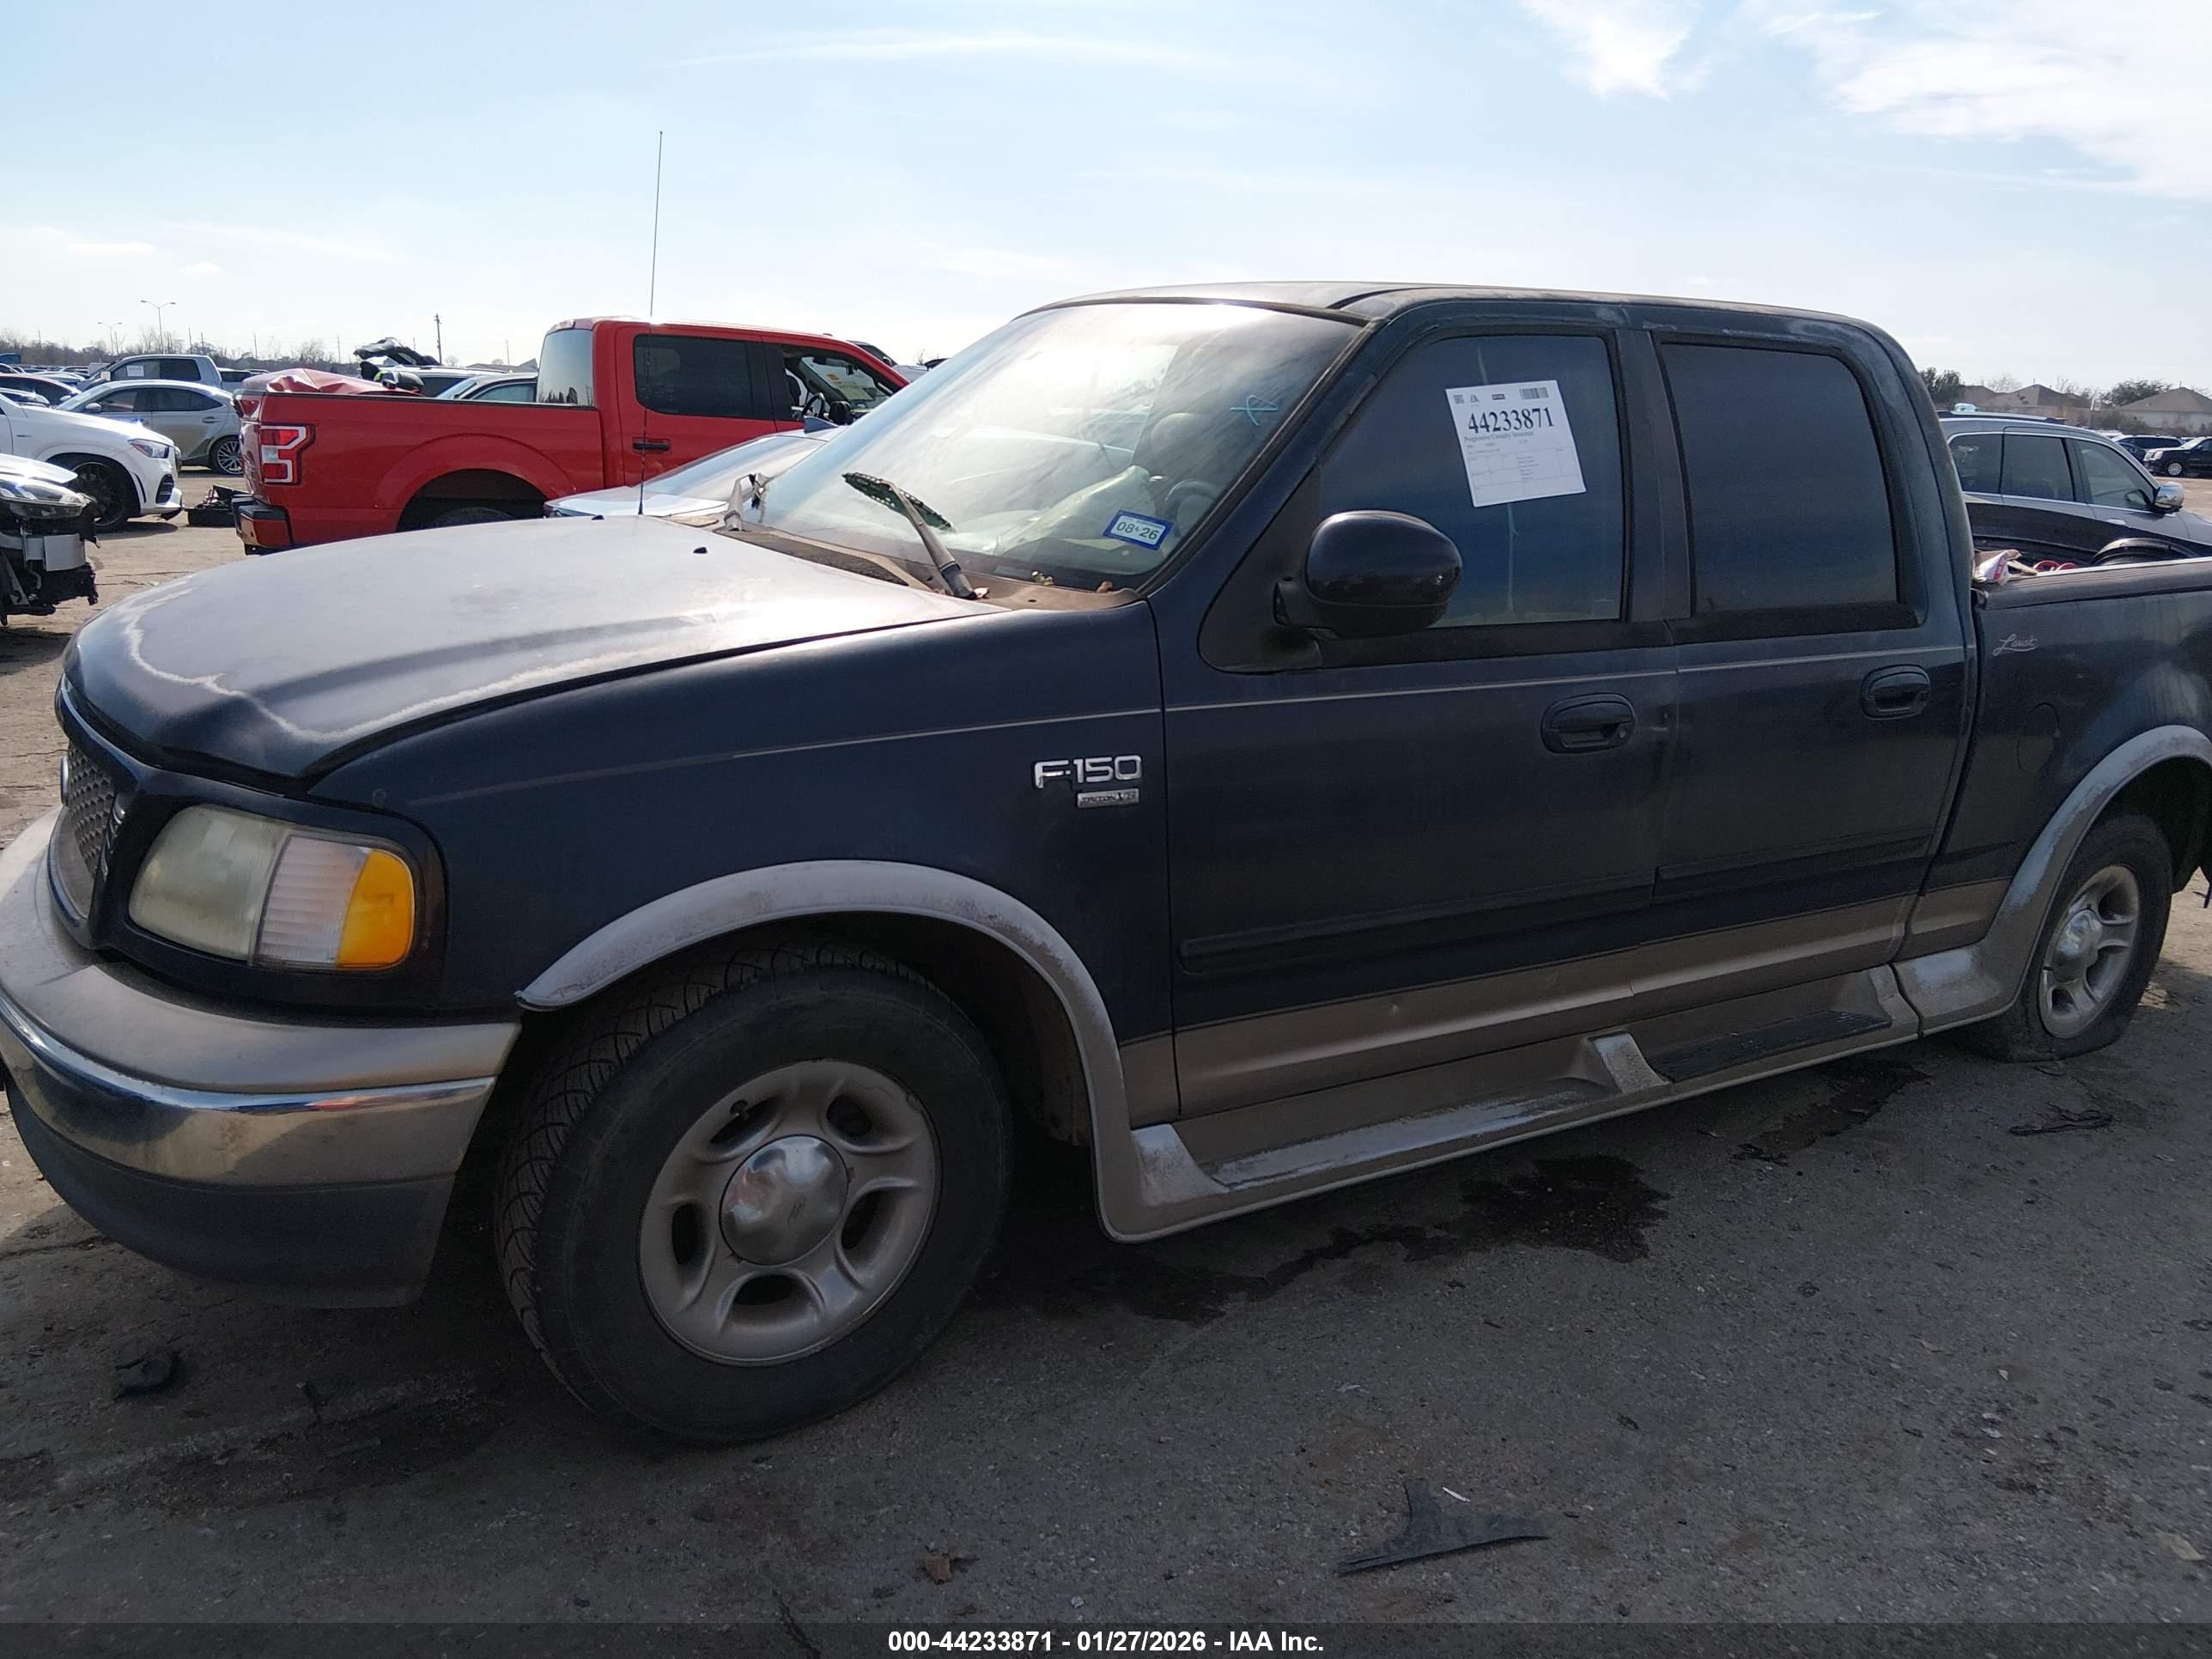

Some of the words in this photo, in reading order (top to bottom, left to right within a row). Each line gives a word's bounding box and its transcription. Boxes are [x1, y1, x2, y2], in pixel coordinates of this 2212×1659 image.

[1468, 407, 1555, 434] 44233871
[1116, 521, 1135, 534] 08
[1139, 527, 1160, 540] 26
[1035, 755, 1142, 789] F-150
